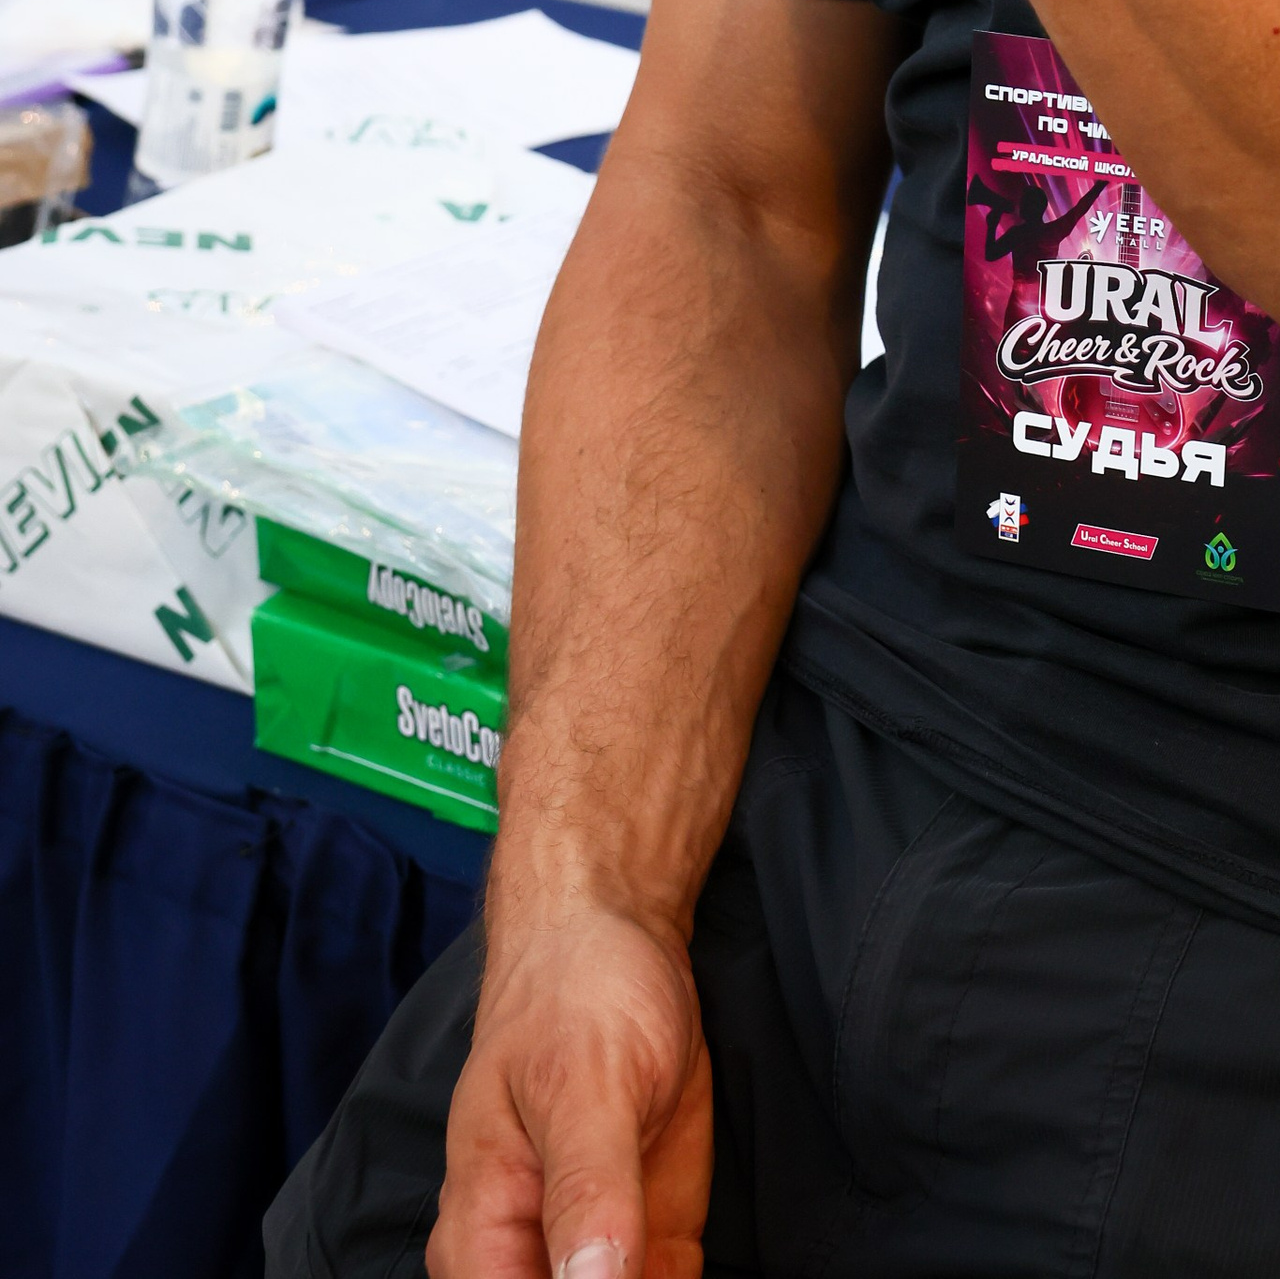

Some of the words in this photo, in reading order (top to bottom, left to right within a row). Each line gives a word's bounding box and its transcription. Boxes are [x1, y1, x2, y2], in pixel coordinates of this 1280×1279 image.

[1038, 115, 1068, 134] ПО
[1079, 120, 1113, 140] ЧИ
[1012, 149, 1089, 172] УРАЛЬСКОЙ
[1116, 236, 1163, 252] MALL
[1038, 261, 1232, 355] URAL
[998, 315, 1114, 371] Cheer
[1114, 333, 1141, 363] &
[1141, 334, 1260, 399] Rock
[1013, 410, 1227, 488] СУДЬЯ
[1080, 529, 1098, 544] Ural
[1100, 534, 1122, 549] Cheer
[1123, 538, 1149, 553] School
